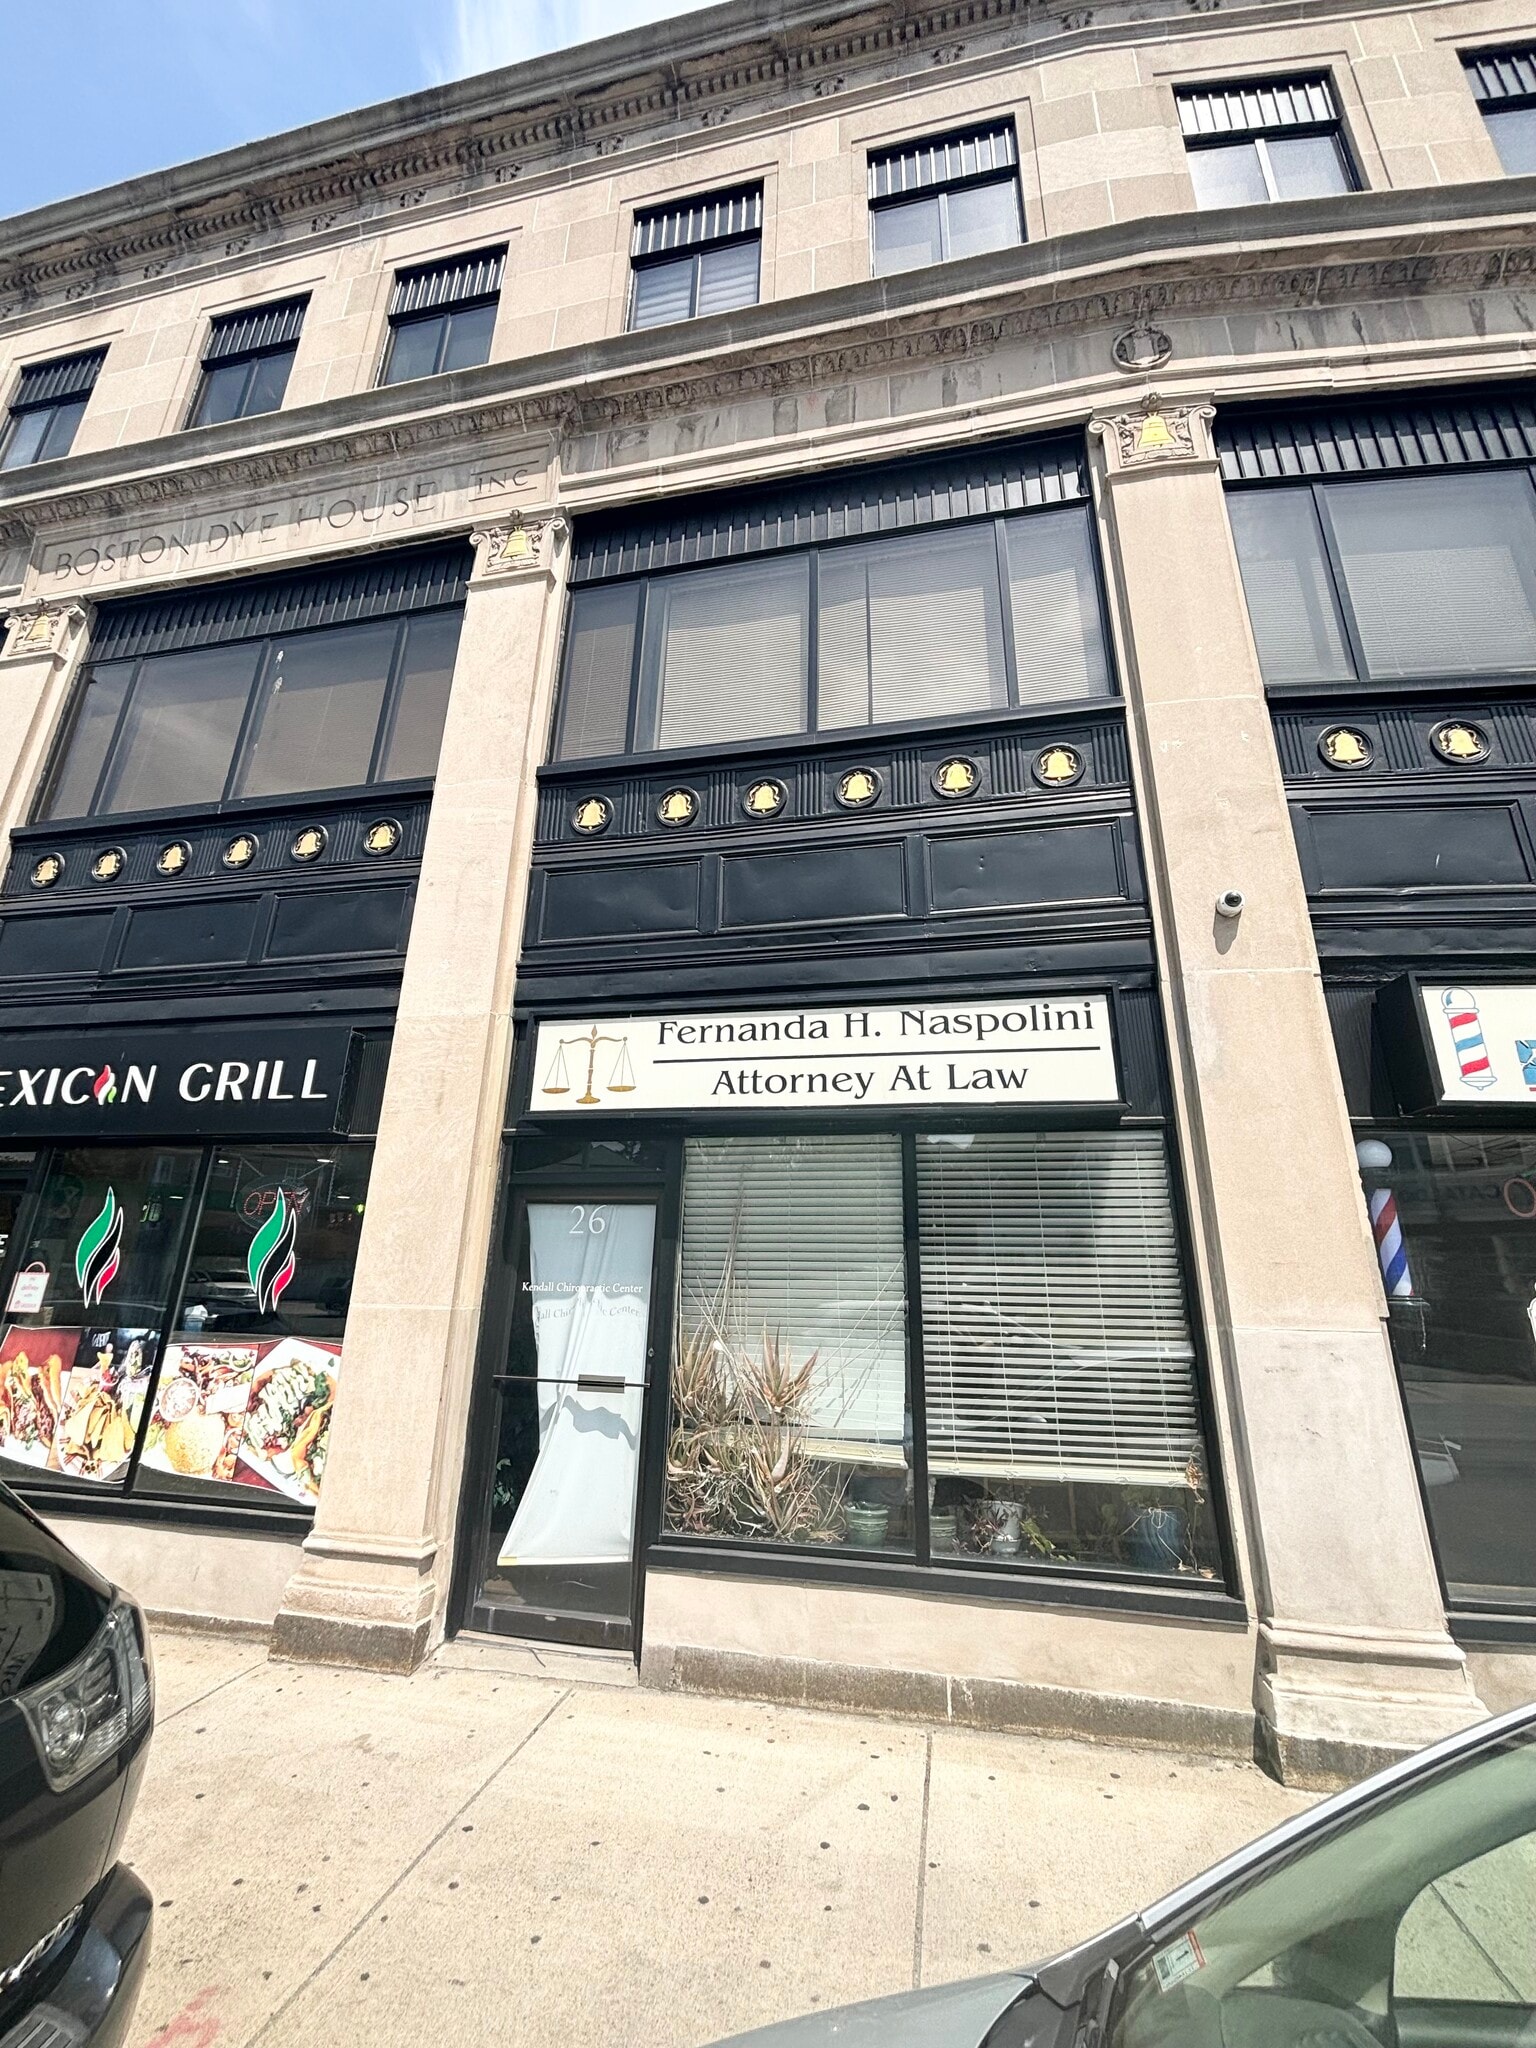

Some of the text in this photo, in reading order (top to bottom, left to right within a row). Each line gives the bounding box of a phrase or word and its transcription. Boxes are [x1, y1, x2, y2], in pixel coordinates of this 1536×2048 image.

[475, 469, 529, 495] INC
[55, 481, 437, 581] BOSTON DYE HOUSE
[657, 1001, 1094, 1046] Fernanda H. Naspolini
[178, 1059, 328, 1102] GRILL
[710, 1063, 1029, 1099] Attorney At Law
[568, 1205, 608, 1234] 26
[522, 1281, 643, 1294] Kendall Chiropractic Center
